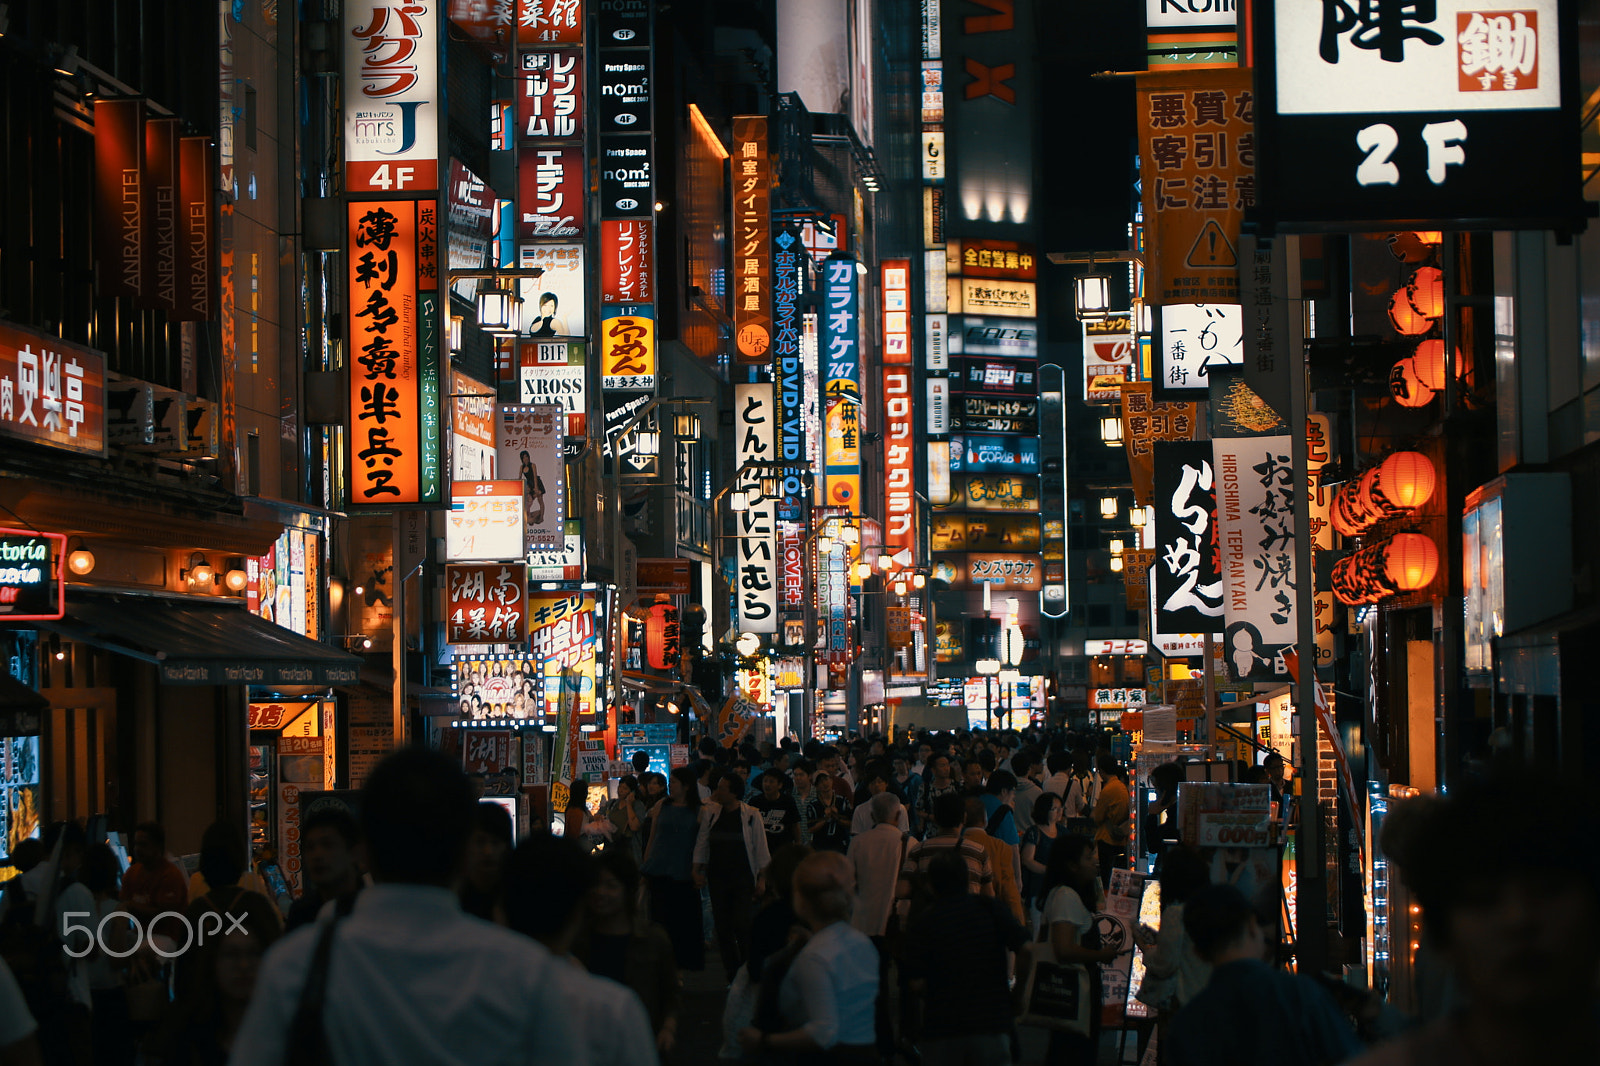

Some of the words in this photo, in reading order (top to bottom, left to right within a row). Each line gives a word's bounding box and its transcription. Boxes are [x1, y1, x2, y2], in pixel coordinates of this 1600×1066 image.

[539, 29, 560, 41] 4F
[618, 30, 630, 38] 5F
[352, 0, 427, 98] バクラ
[526, 54, 547, 67] 3F
[605, 64, 623, 72] Party
[624, 64, 645, 72] Space
[1478, 73, 1517, 90] すき
[553, 53, 576, 136] レンタル
[526, 75, 549, 136] ルーム
[620, 115, 631, 123] 4F
[1356, 119, 1468, 186] 2F
[369, 164, 415, 190] 4F
[536, 151, 563, 214] エデン
[621, 201, 632, 209] 3F
[122, 168, 139, 289] ANRAKUTEI
[532, 215, 579, 237] Eden
[741, 142, 760, 311] 個室ダイニング居酒屋
[157, 186, 174, 302] ANRAKUTEI
[536, 248, 580, 260] タイ古式
[639, 222, 648, 267] レンタルルーム
[190, 202, 207, 315] ANRAKUTEI
[523, 261, 580, 271] マッサージ
[618, 222, 635, 301] リフレッシュ
[964, 248, 1033, 270] 全店営業中
[639, 272, 648, 297] ホステル
[620, 307, 637, 315] 1F
[774, 250, 798, 354] ホテルがライバル
[829, 260, 854, 359] カラオケ
[967, 327, 1033, 341] FACE
[540, 344, 565, 361] B1F
[1168, 328, 1189, 386] 一番街
[828, 363, 854, 377] 747
[524, 378, 582, 394] XROSS
[605, 376, 653, 388] 博多天神
[605, 405, 627, 422] Party
[624, 395, 650, 416] Space
[1130, 415, 1189, 434] 客引き
[475, 485, 494, 495] 2F
[1222, 454, 1241, 521] HIROSHIMA
[467, 501, 518, 512] タイ古式
[452, 515, 519, 528] マッサージ
[972, 559, 1035, 576] メンズサウナ
[452, 566, 521, 606] 湖南
[534, 592, 584, 624] キラリ
[533, 611, 593, 658] 出会い
[1101, 641, 1145, 653] コーヒー
[555, 641, 593, 674] カフェ
[1095, 688, 1146, 705] 無料案
[294, 739, 310, 750] 20
[582, 756, 607, 764] XROSS
